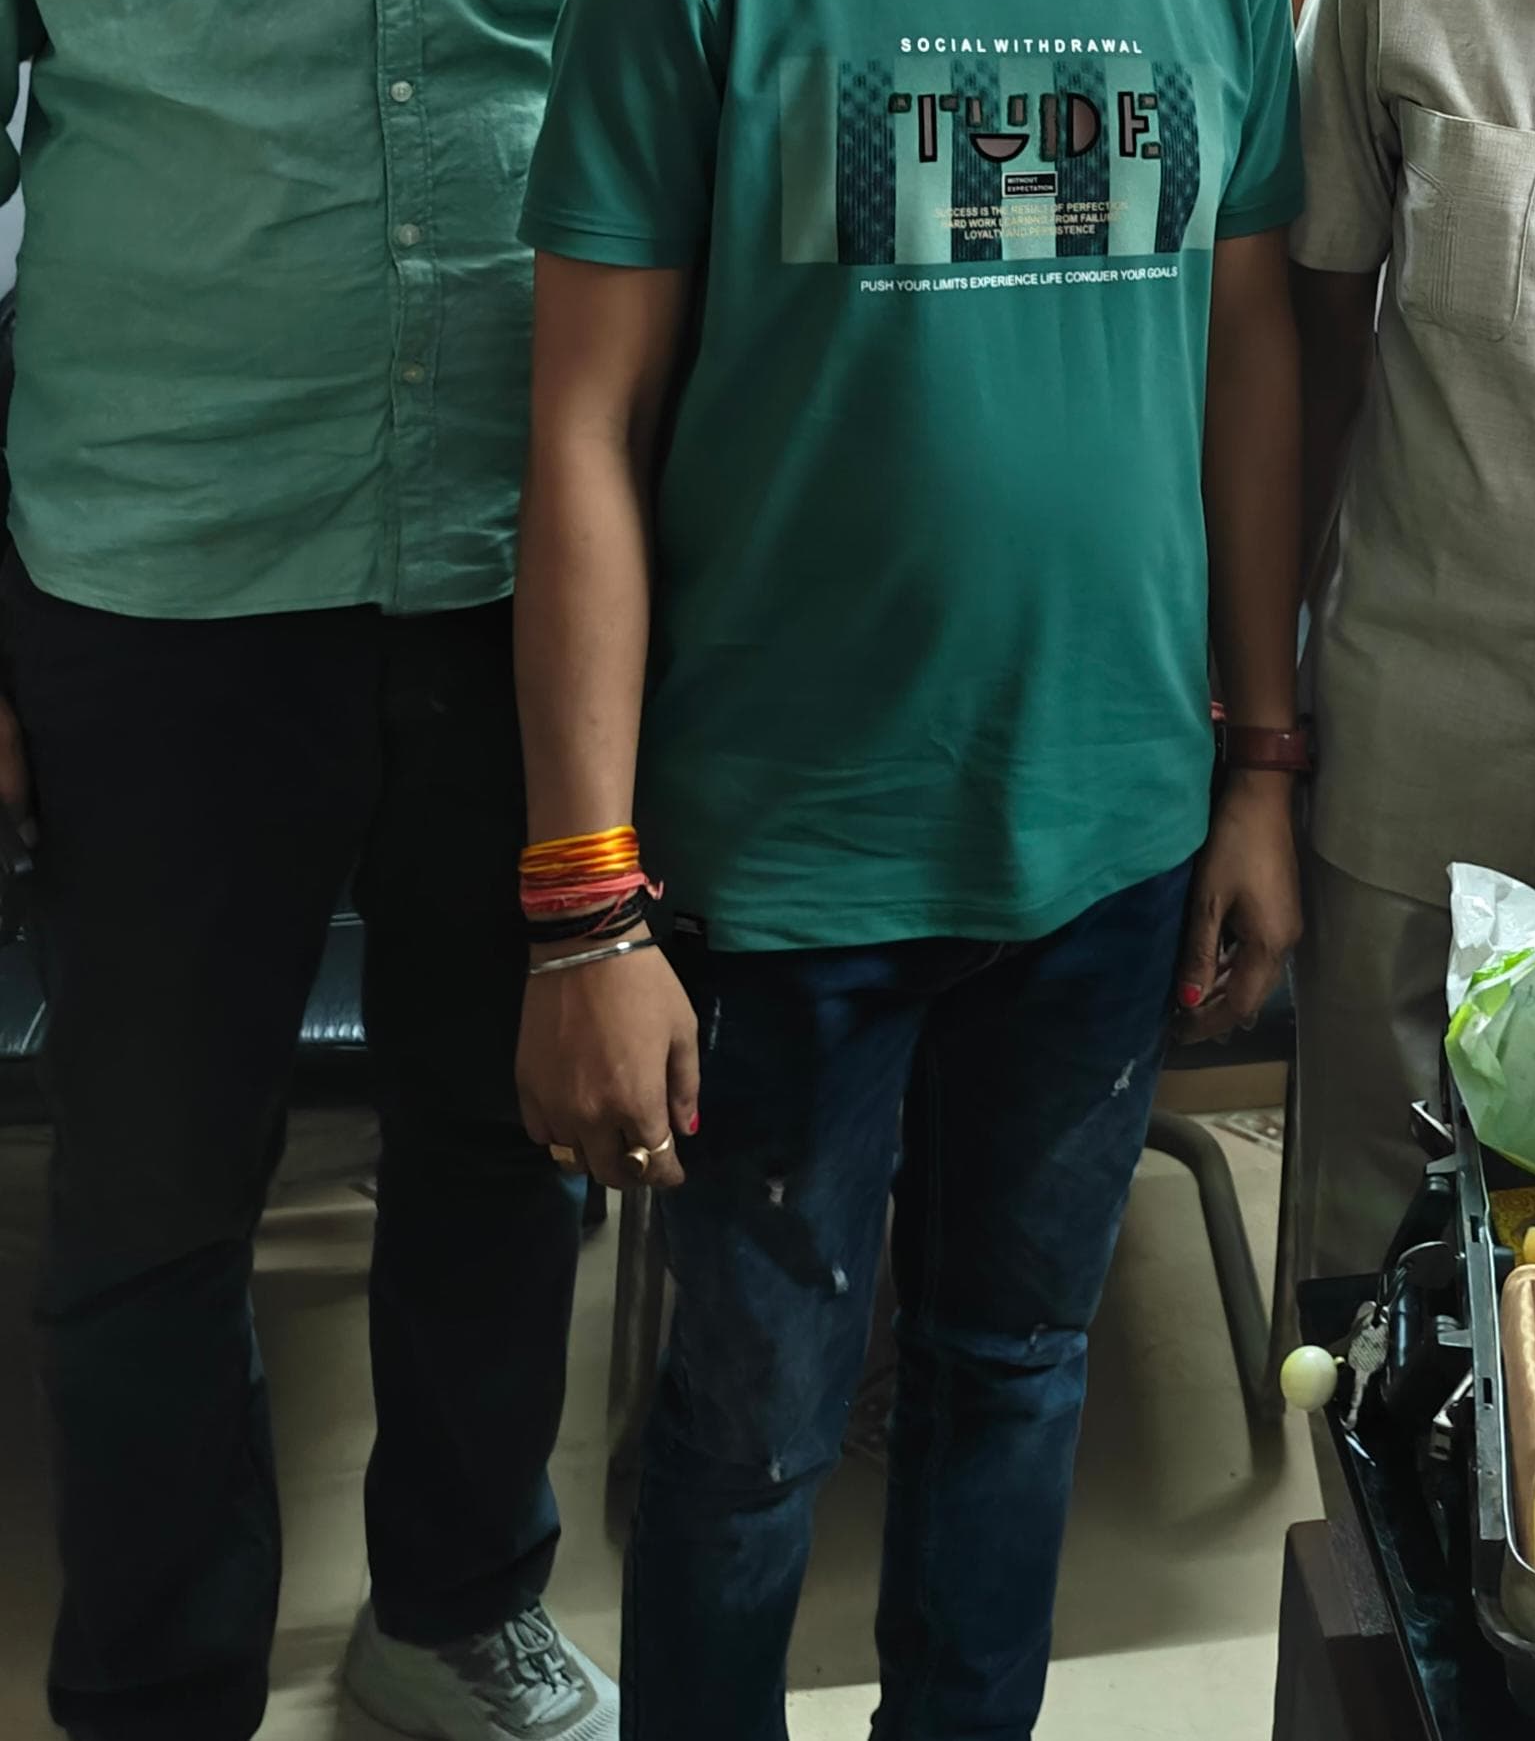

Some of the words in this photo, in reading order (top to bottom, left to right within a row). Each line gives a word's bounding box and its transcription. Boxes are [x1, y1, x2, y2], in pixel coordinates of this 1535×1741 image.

[900, 36, 987, 54] SOCIAL
[994, 38, 1143, 55] WITHDRAWAL
[861, 279, 895, 292] PUSH
[898, 278, 931, 291] YOUR
[933, 276, 968, 290] LIMITS
[970, 273, 1038, 288] EXPERIENCE
[1040, 272, 1063, 285] LIFE
[1065, 269, 1118, 284] CONQUER
[1120, 268, 1147, 280] YOUR
[1147, 266, 1178, 279] GOALS
